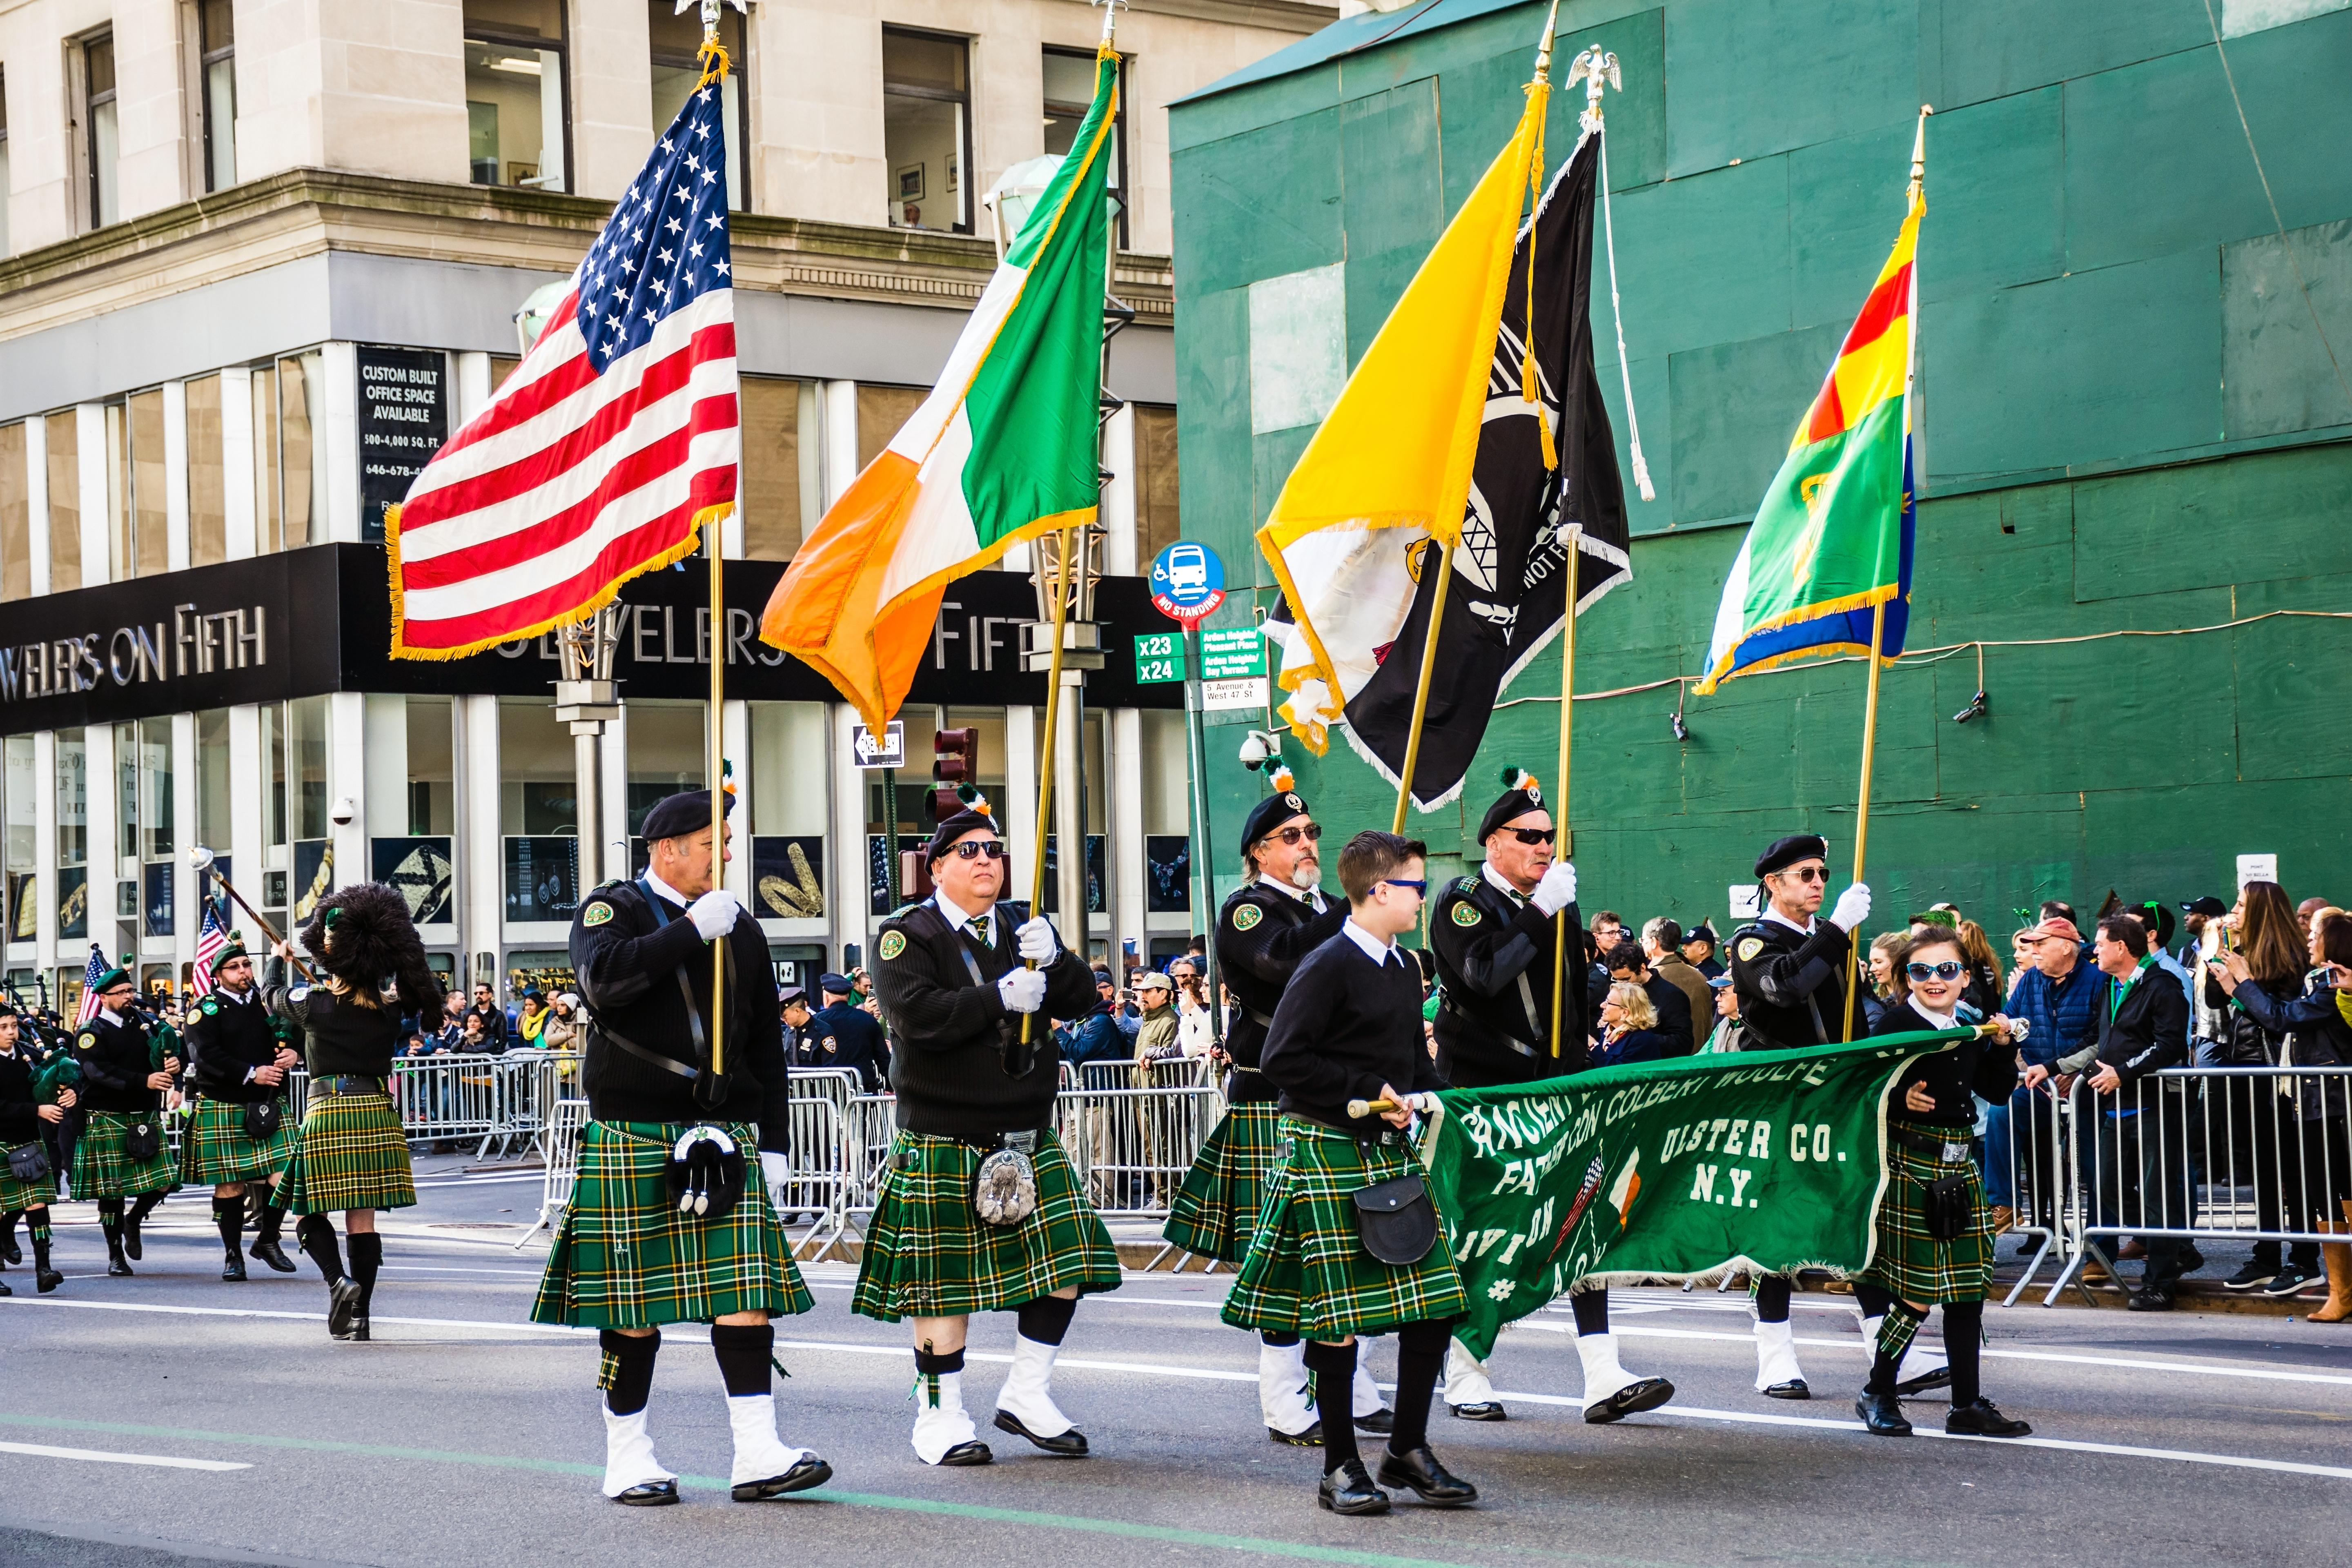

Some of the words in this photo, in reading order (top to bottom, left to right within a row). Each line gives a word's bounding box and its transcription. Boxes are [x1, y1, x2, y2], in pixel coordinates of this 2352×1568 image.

[363, 365, 406, 382] CUSTOM
[409, 369, 438, 385] BUILT
[366, 385, 402, 401] OFFICE
[404, 388, 435, 404] SPACE
[373, 405, 429, 423] AVAILABLE
[365, 434, 408, 447] 500-4,000
[412, 437, 426, 448] SQ.
[428, 437, 440, 448] FT.
[366, 464, 424, 477] 646-678-4
[1523, 553, 1555, 589] NOT
[1158, 596, 1172, 611] NO
[1173, 593, 1220, 617] STANDING
[110, 623, 167, 686] ON
[175, 603, 266, 676] FIFTH
[936, 602, 1038, 672] FIFT
[1203, 633, 1225, 642] Arden
[1226, 629, 1258, 641] Heights/
[1139, 636, 1172, 656] x23
[1204, 641, 1236, 652] Pleasant
[1237, 641, 1258, 650] Place
[1205, 657, 1227, 666] Arden
[1228, 653, 1259, 665] Heights/
[1140, 660, 1173, 680] x24
[1205, 667, 1220, 677] Bay
[1221, 666, 1249, 675] Terrace
[861, 738, 874, 753] ONE
[1661, 1119, 1771, 1164] ULSTER
[1791, 1123, 1846, 1162] CO.
[1690, 1163, 1758, 1208] N.Y.
